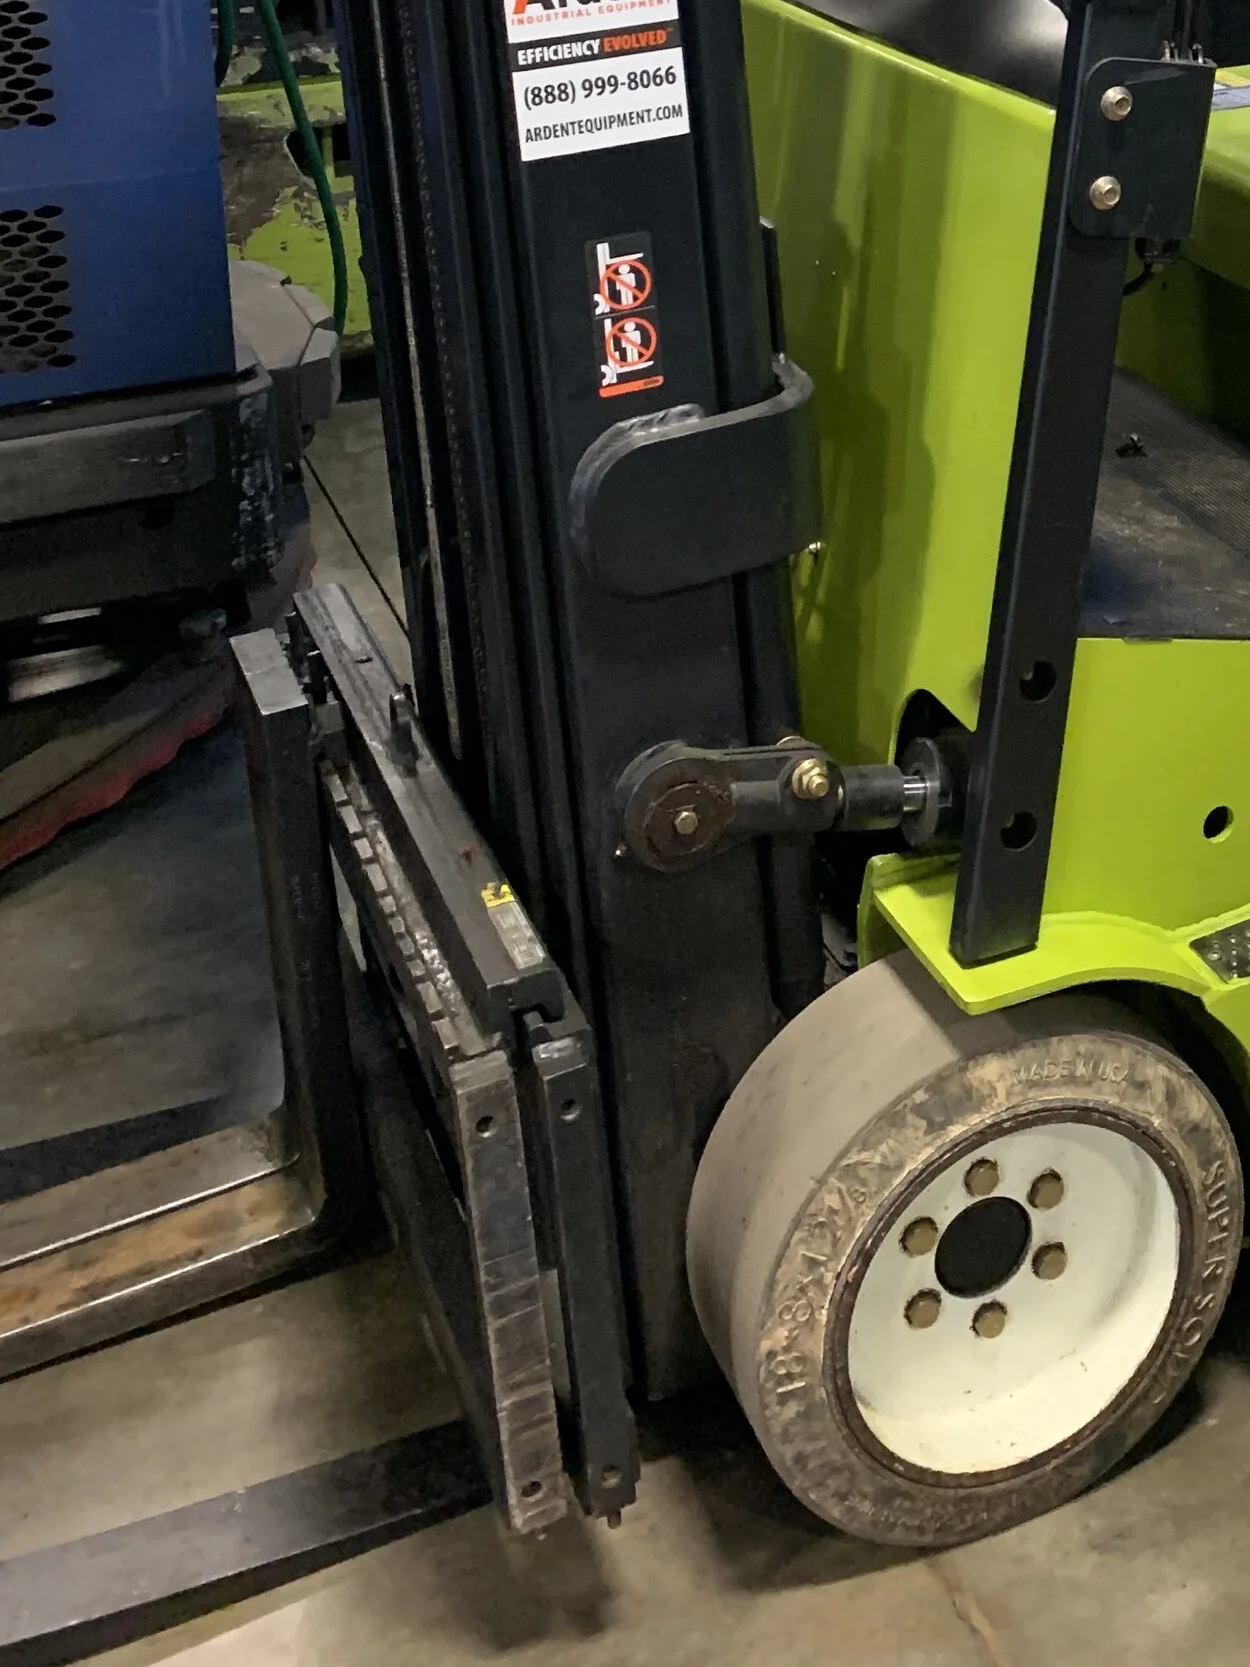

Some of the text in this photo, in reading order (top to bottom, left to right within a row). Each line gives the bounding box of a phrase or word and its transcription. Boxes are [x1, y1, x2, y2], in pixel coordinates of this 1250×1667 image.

[511, 8, 592, 26] INDUSTRIAL
[517, 39, 600, 66] EFFICIENCY
[524, 65, 677, 111] (888) 999-8066
[525, 103, 683, 143] ARDENTEQUIPMENT.COM
